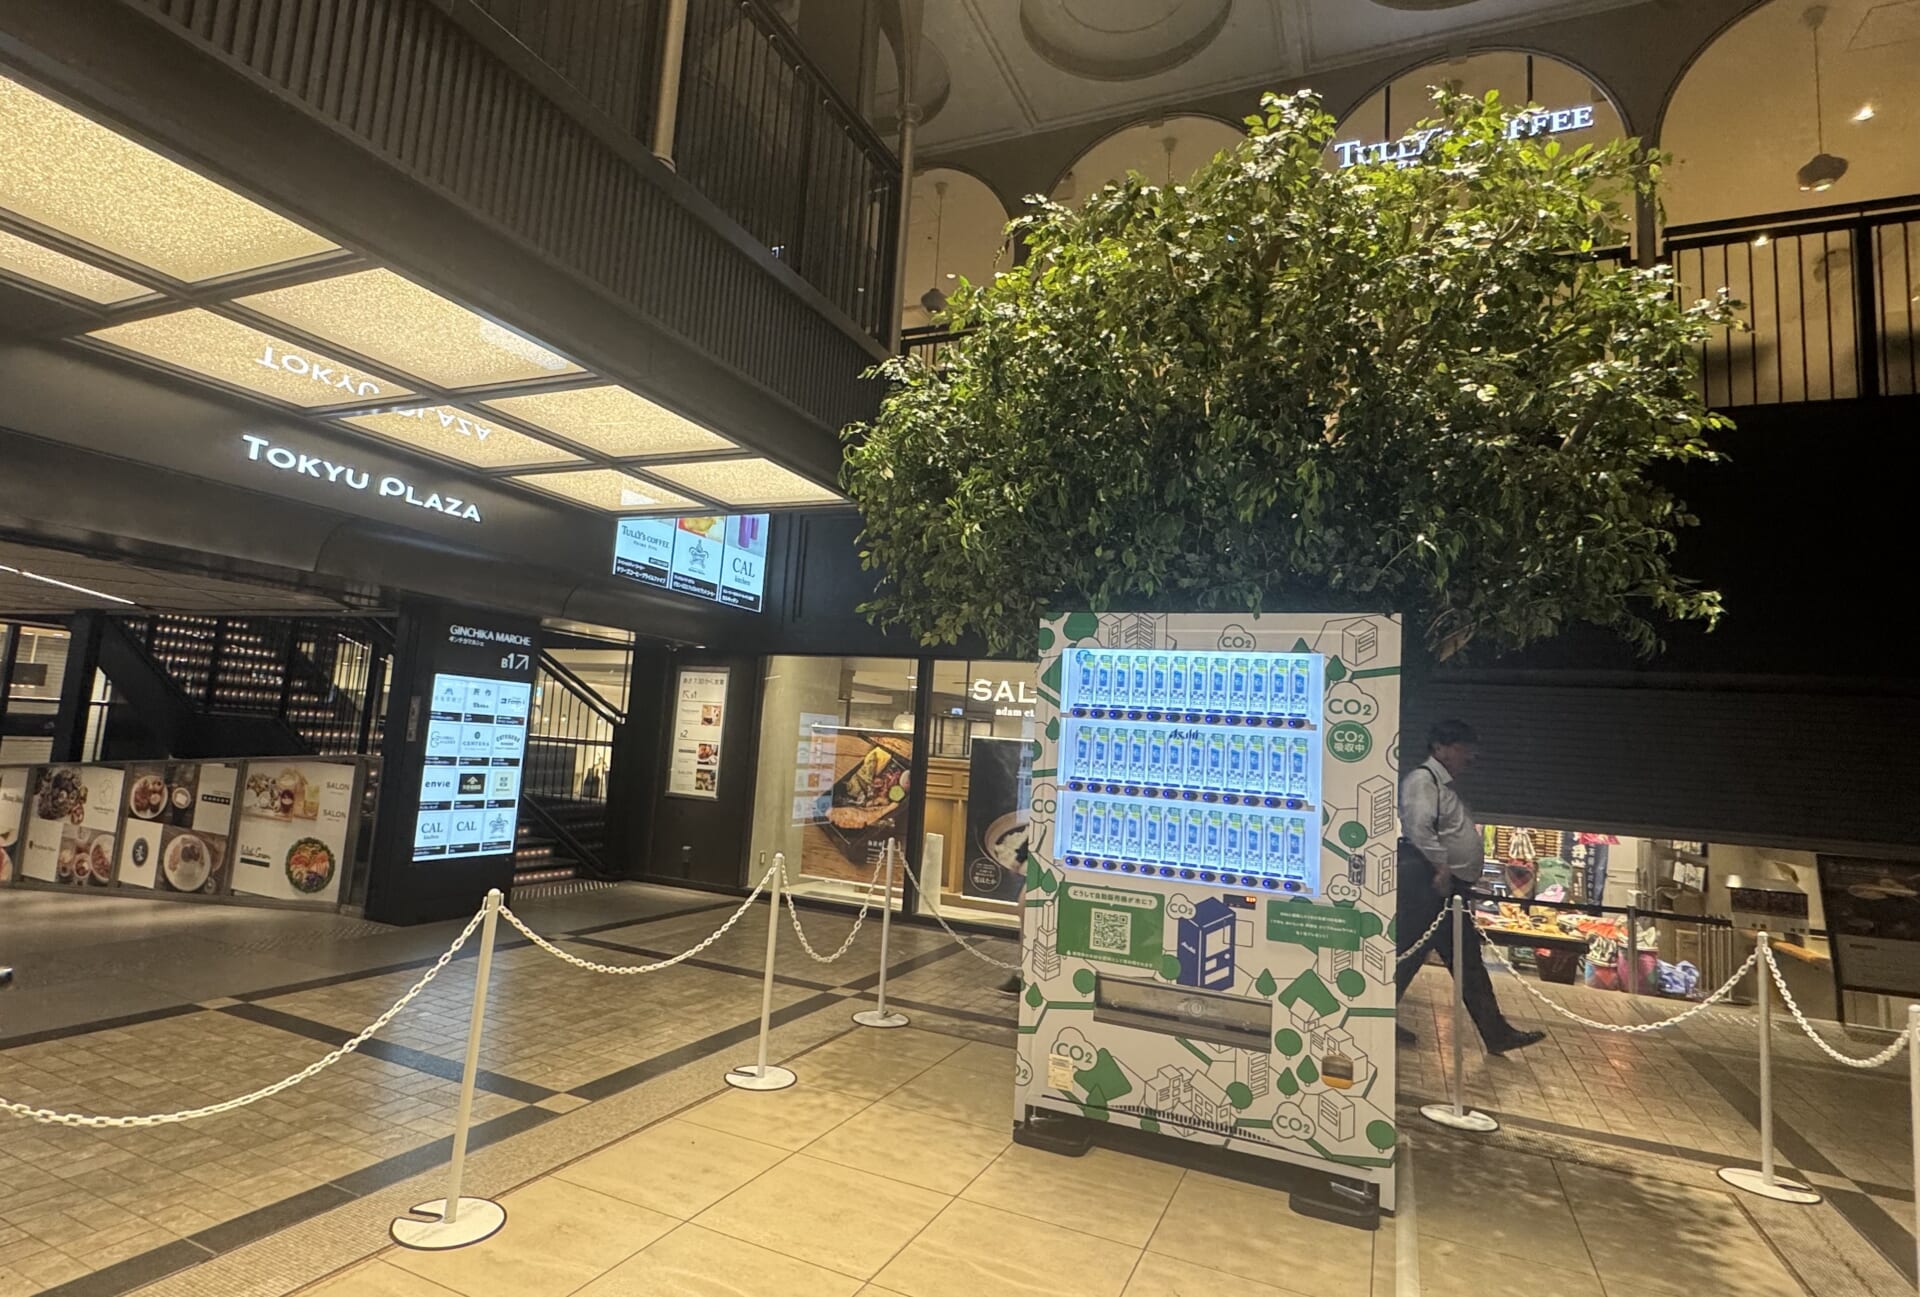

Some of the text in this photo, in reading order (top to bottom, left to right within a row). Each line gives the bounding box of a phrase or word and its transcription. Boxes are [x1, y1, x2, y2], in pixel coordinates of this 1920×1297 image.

[242, 434, 481, 523] TOKYU PLAZA
[646, 535, 670, 549] COFFEE
[732, 557, 756, 578] CAL
[449, 624, 532, 647] GINCHIKA MARCHE
[501, 653, 515, 669] B1
[972, 678, 1037, 704] SAL
[995, 706, 1035, 717] adam et
[1168, 728, 1199, 740] Asahi
[1333, 742, 1365, 753] 吸収中
[326, 781, 350, 792] SALON
[425, 780, 451, 788] envie
[1032, 799, 1057, 814] CO
[323, 808, 346, 818] SALON
[421, 823, 444, 833] CAL
[456, 821, 477, 832] CAL
